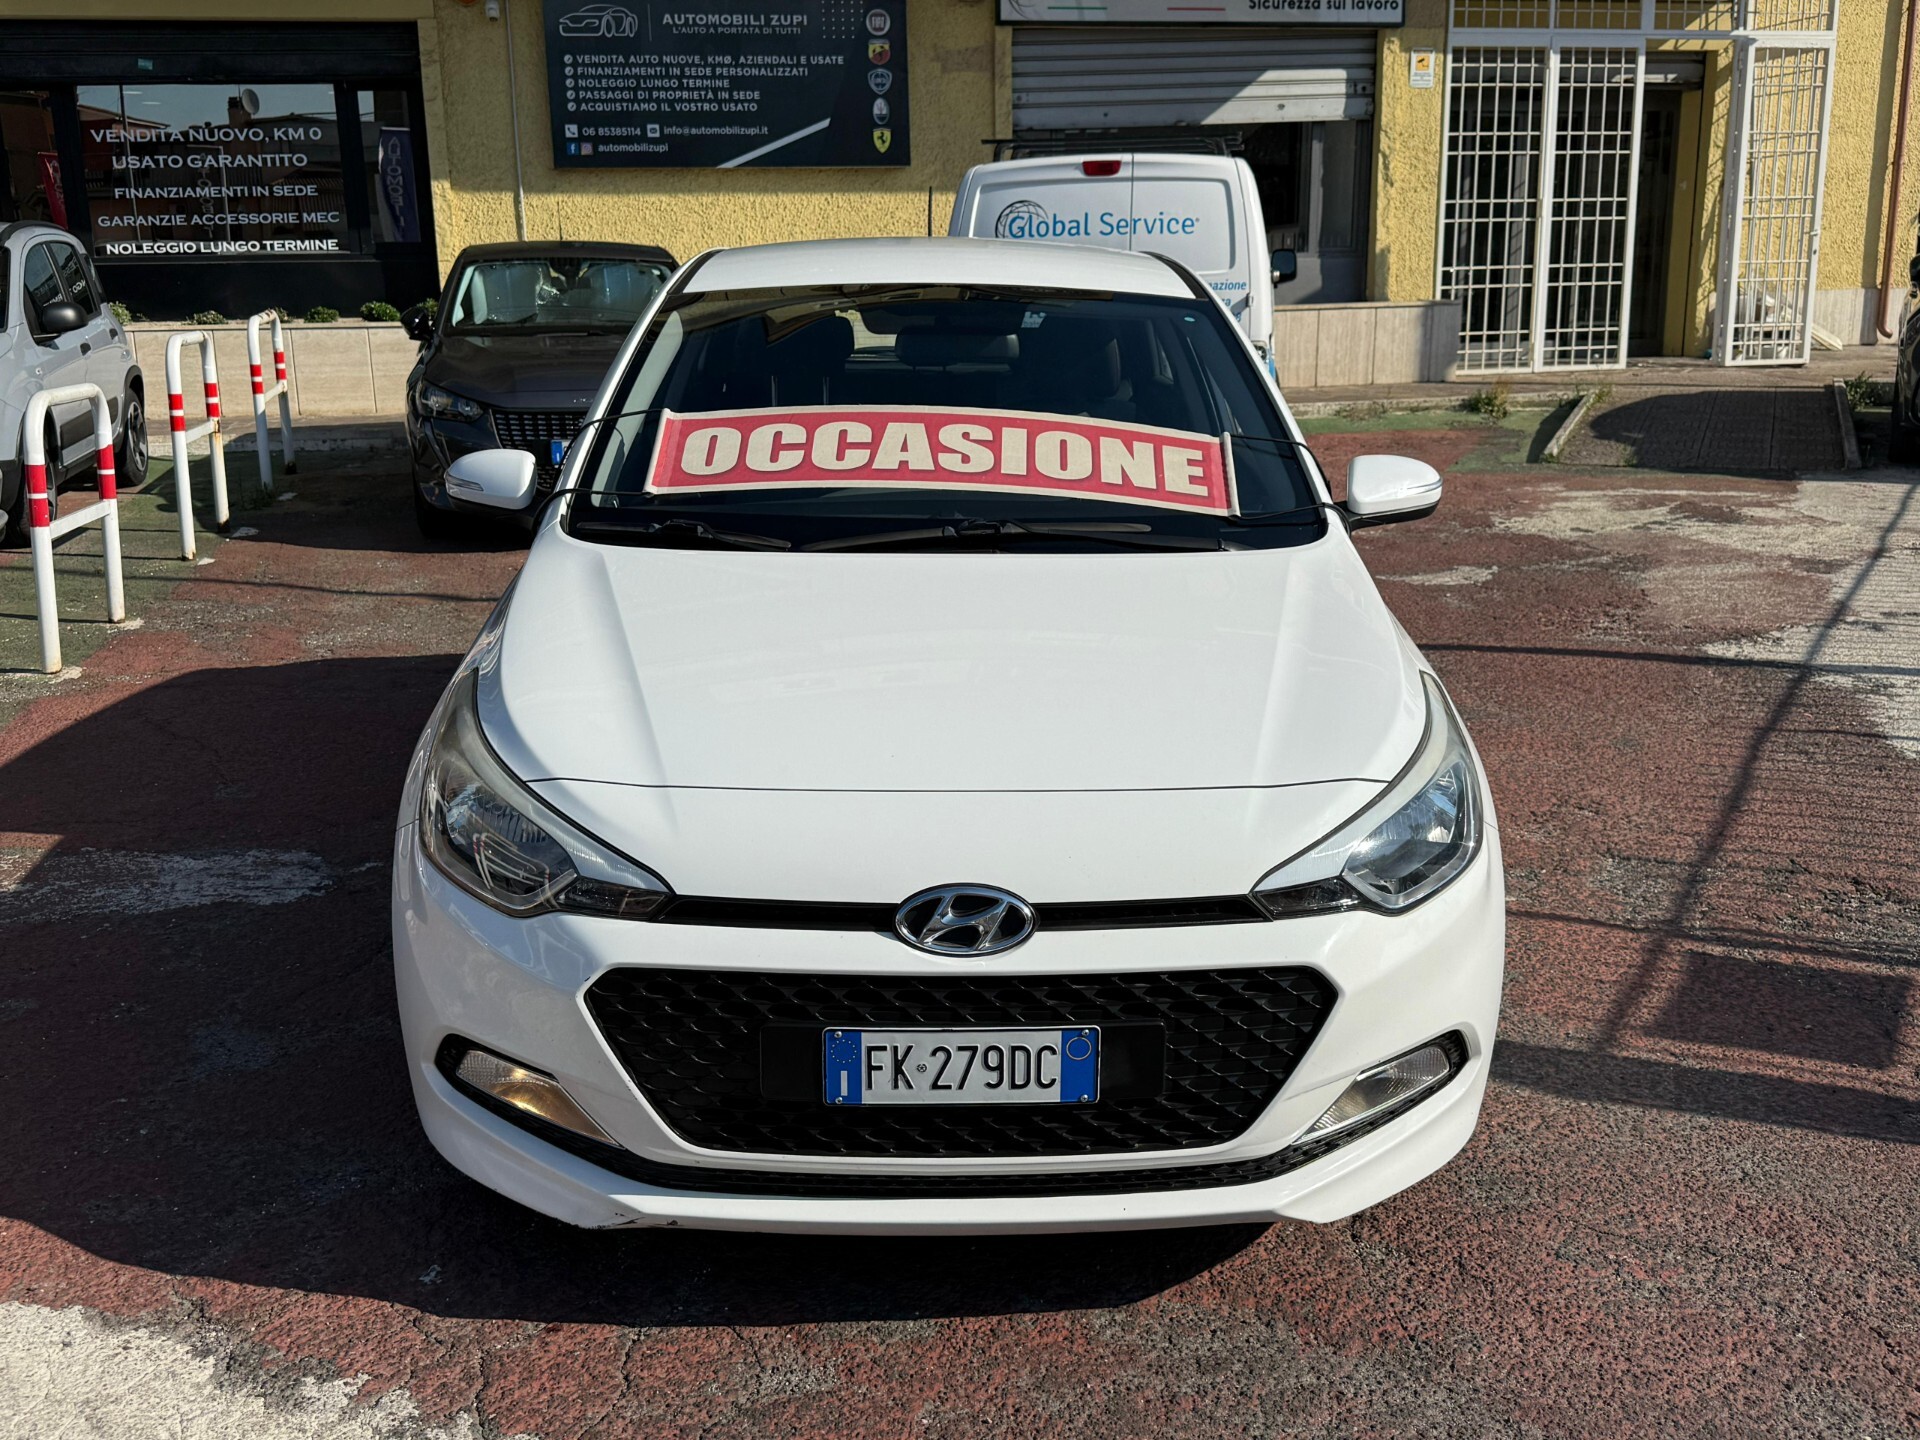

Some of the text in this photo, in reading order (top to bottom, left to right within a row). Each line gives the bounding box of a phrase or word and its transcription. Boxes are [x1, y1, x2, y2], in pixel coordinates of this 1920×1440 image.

[1326, 0, 1346, 10] sul
[1351, 0, 1399, 10] lavoro
[663, 13, 808, 26] AUTOMOBILI ZUPI
[673, 26, 706, 34] L'AUTO
[775, 27, 801, 35] TUTTI
[576, 54, 625, 64] VENDITA
[628, 54, 659, 64] AUTO
[662, 55, 704, 65] NUOVE,
[740, 55, 797, 65] AZIENDALI
[801, 56, 807, 64] E
[810, 56, 844, 65] USATE
[577, 67, 808, 77] FINANZIAMENTI IN SEDE PERSONALIZZATI
[578, 78, 730, 88] NOLEGGIO LUNGO TERMINE
[579, 89, 760, 100] PASSAGGI DI PROPRIETÀ IN SEDE
[580, 102, 758, 112] ACQUISTIAMO IL VOSTRO USATO
[90, 128, 184, 143] VENDITA
[188, 127, 270, 144] NUOVO,
[274, 127, 304, 141] KM
[582, 126, 769, 137] 06 85385114 info@automobilizupi.it
[598, 143, 669, 153] automobilizupi
[112, 153, 308, 169] USATO GARANTITO
[114, 185, 319, 199] FINANZIAMENTI IN SEDE
[98, 211, 340, 227] GARANZIE ACCESSORIE MEC
[1008, 212, 1091, 239] Global
[106, 239, 339, 255] NOLEGGIO LUNGO TERMINE
[680, 421, 1208, 497] OCCASIONE
